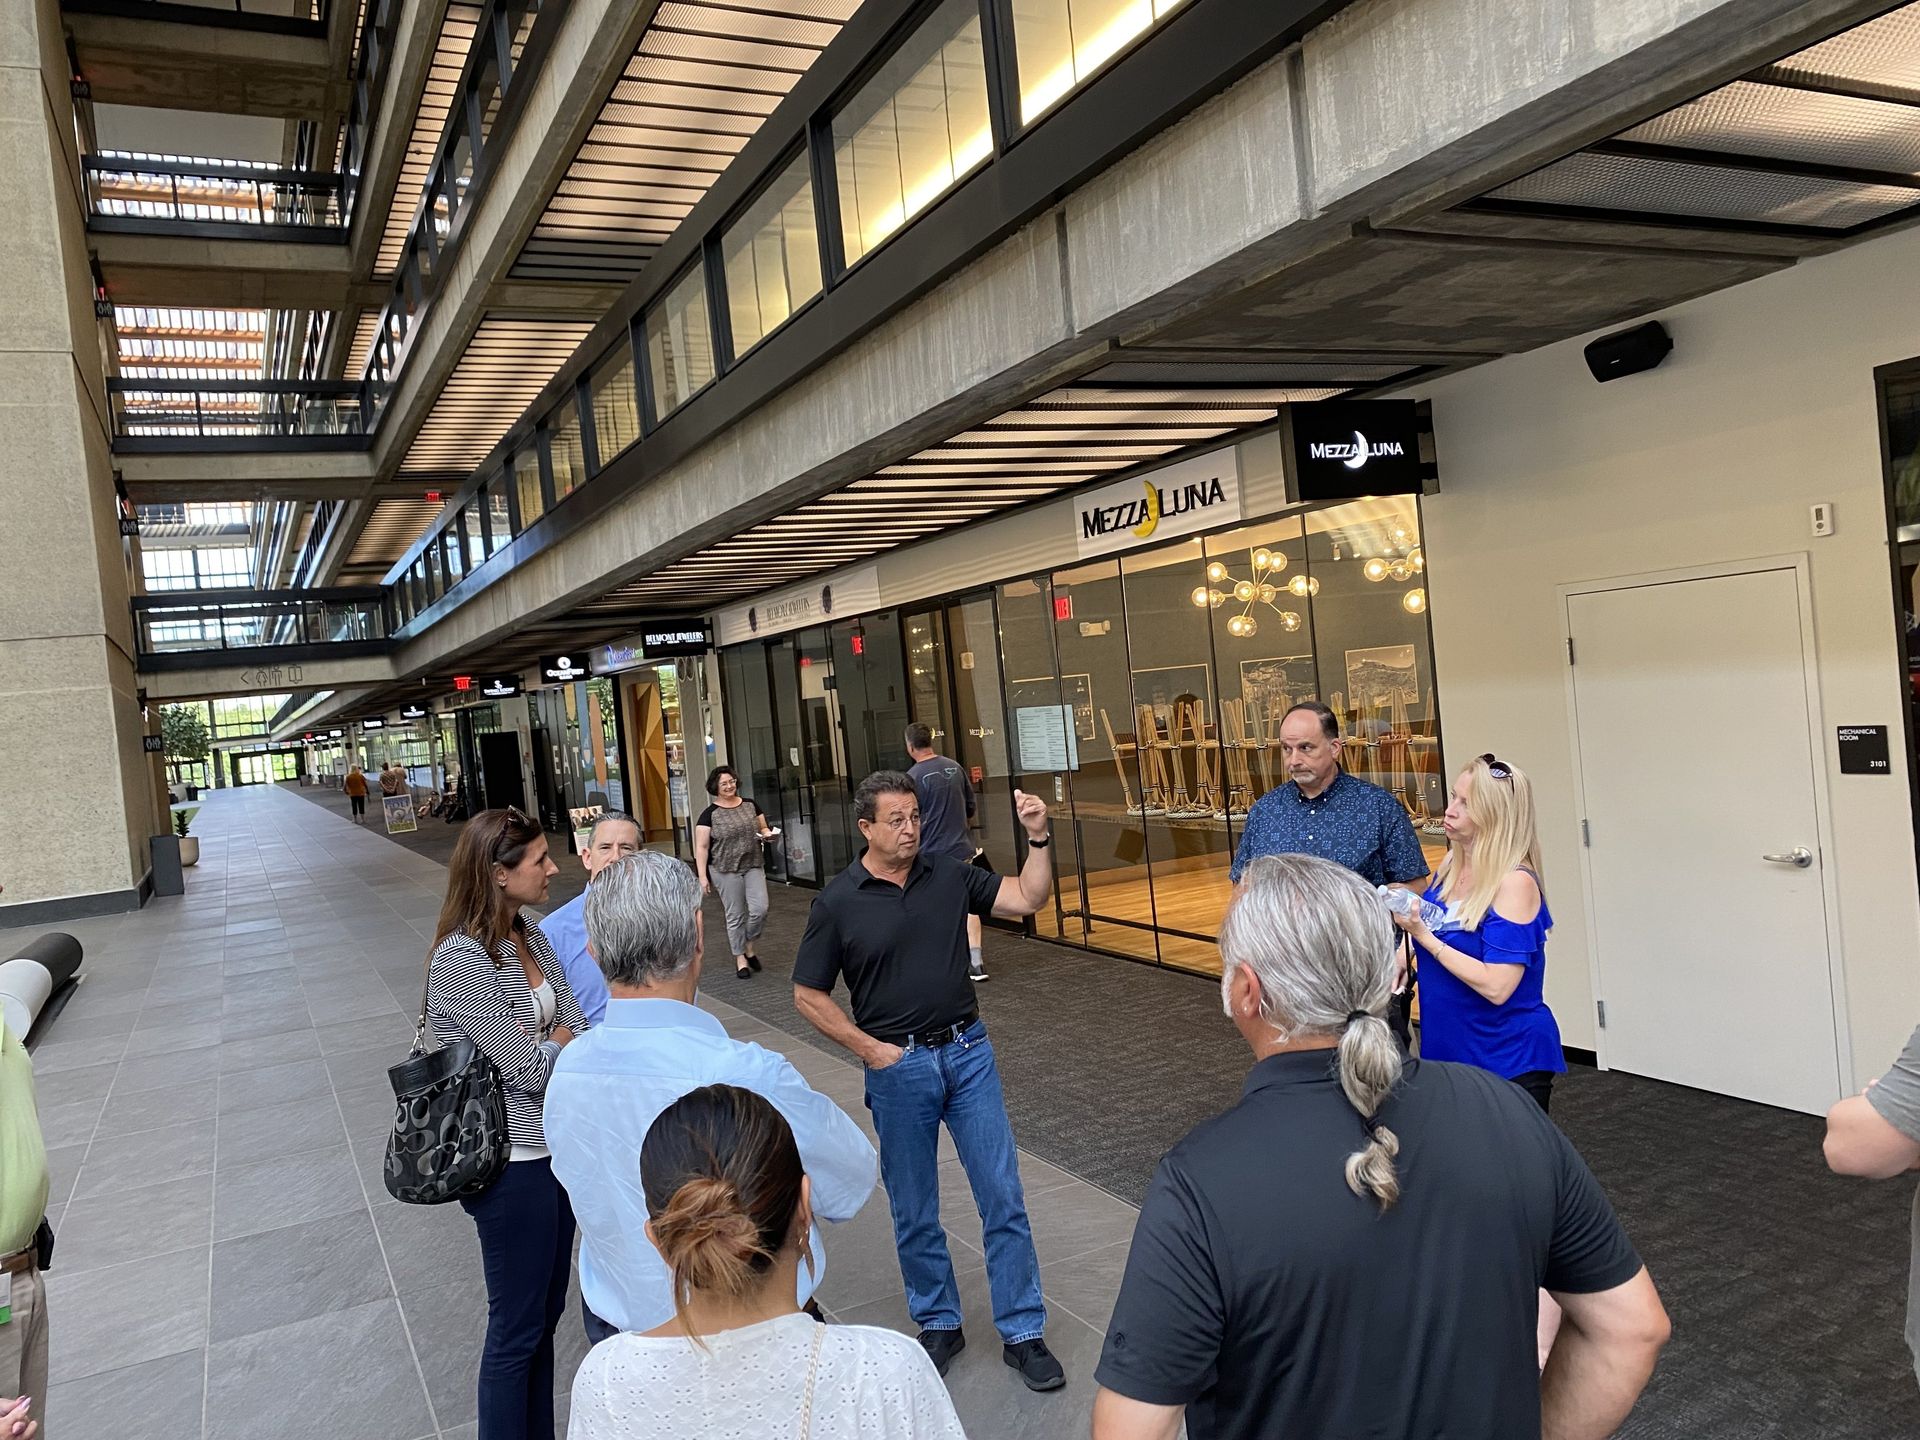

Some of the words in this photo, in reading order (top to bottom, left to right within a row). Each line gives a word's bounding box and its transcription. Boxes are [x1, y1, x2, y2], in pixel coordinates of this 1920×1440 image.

[1310, 443, 1360, 459] MEZZA
[1362, 442, 1404, 457] LUNA
[1082, 498, 1151, 538] MEZZA
[1157, 478, 1226, 518] LUNA
[645, 632, 675, 643] BELMONT
[676, 631, 704, 641] JEWELERS
[552, 744, 580, 778] EAT
[1870, 760, 1887, 768] 3101
